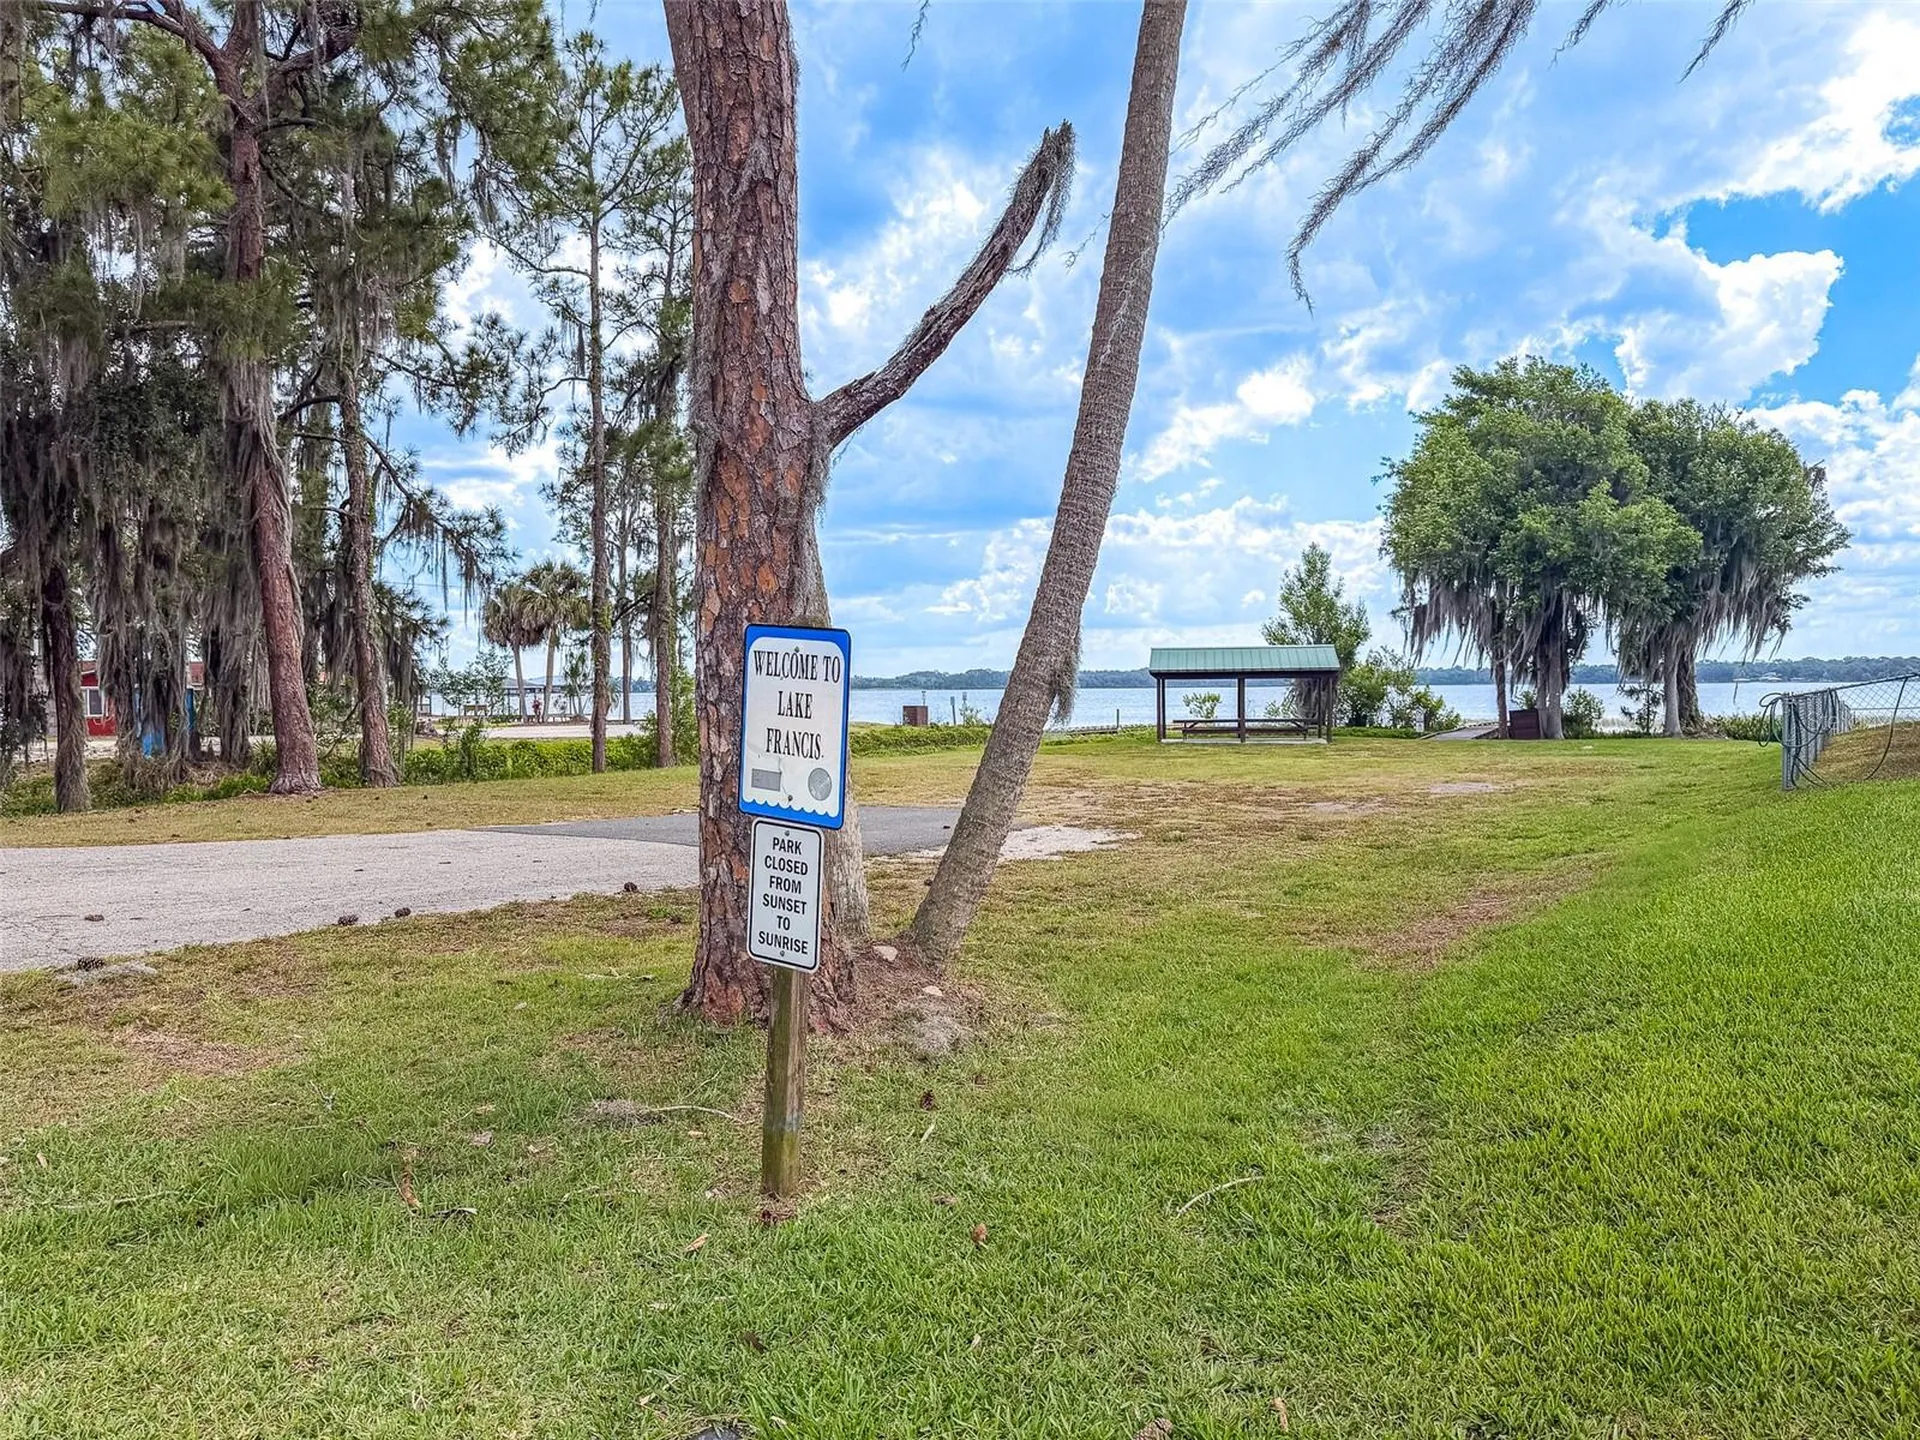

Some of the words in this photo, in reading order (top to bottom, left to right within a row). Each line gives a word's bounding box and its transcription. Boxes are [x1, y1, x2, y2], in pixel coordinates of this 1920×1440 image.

[753, 650, 818, 681] WELCOME
[822, 656, 841, 684] TO
[777, 691, 813, 720] LAKE
[765, 728, 825, 760] FRANCIS.
[772, 837, 802, 855] PARK
[764, 855, 809, 876] CLOSED
[769, 876, 802, 894] FROM
[762, 893, 807, 915] SUNSET
[776, 915, 791, 931] TO
[758, 930, 809, 955] SUNRISE
